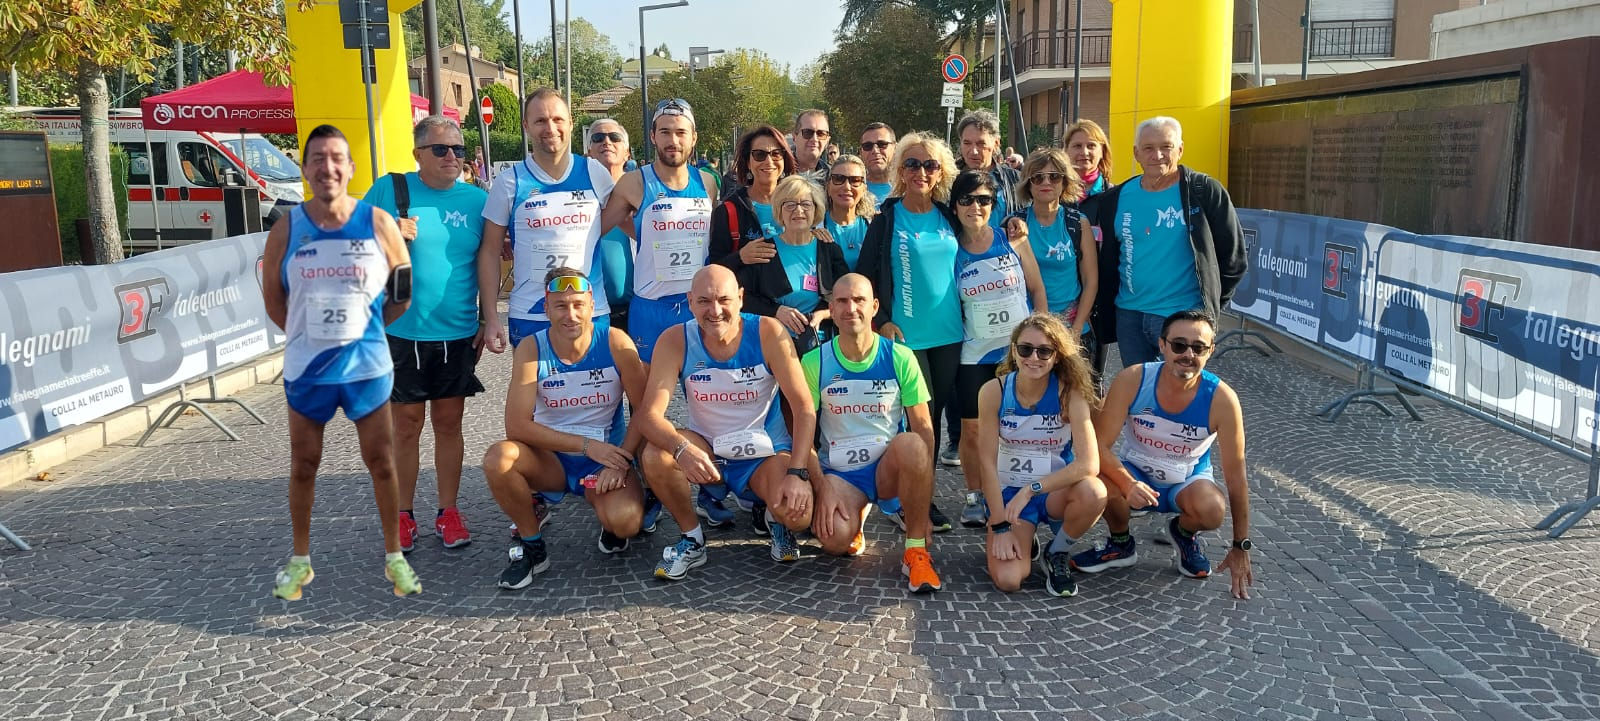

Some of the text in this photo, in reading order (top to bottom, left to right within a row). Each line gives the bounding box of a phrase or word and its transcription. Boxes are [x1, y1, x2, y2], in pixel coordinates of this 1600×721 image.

[108, 121, 144, 130] SOMBRO
[524, 200, 548, 208] AVIS
[652, 203, 673, 211] AVIS
[525, 211, 591, 229] Ranocchi
[652, 218, 708, 231] Ranocchi
[545, 254, 570, 269] 27
[669, 251, 692, 267] 22
[898, 243, 912, 284] MONDOLFO
[1258, 247, 1308, 279] falegnami
[960, 268, 980, 279] AVIS
[173, 279, 242, 319] falegnami
[902, 284, 914, 318] MAROTTA
[323, 309, 348, 324] 25
[987, 310, 1010, 326] 20
[1391, 349, 1450, 377] COLLI AL METAURO
[542, 380, 566, 388] AVIS
[51, 384, 124, 417] COLLI AL METAURO
[542, 391, 611, 408] Ranocchi
[693, 389, 759, 402] Ranocchi
[1133, 417, 1156, 429] AVIS
[1002, 437, 1063, 446] anocchi
[731, 443, 757, 458] 26
[846, 448, 871, 465] 28
[1009, 457, 1034, 474] 24
[1141, 465, 1167, 481] 23
